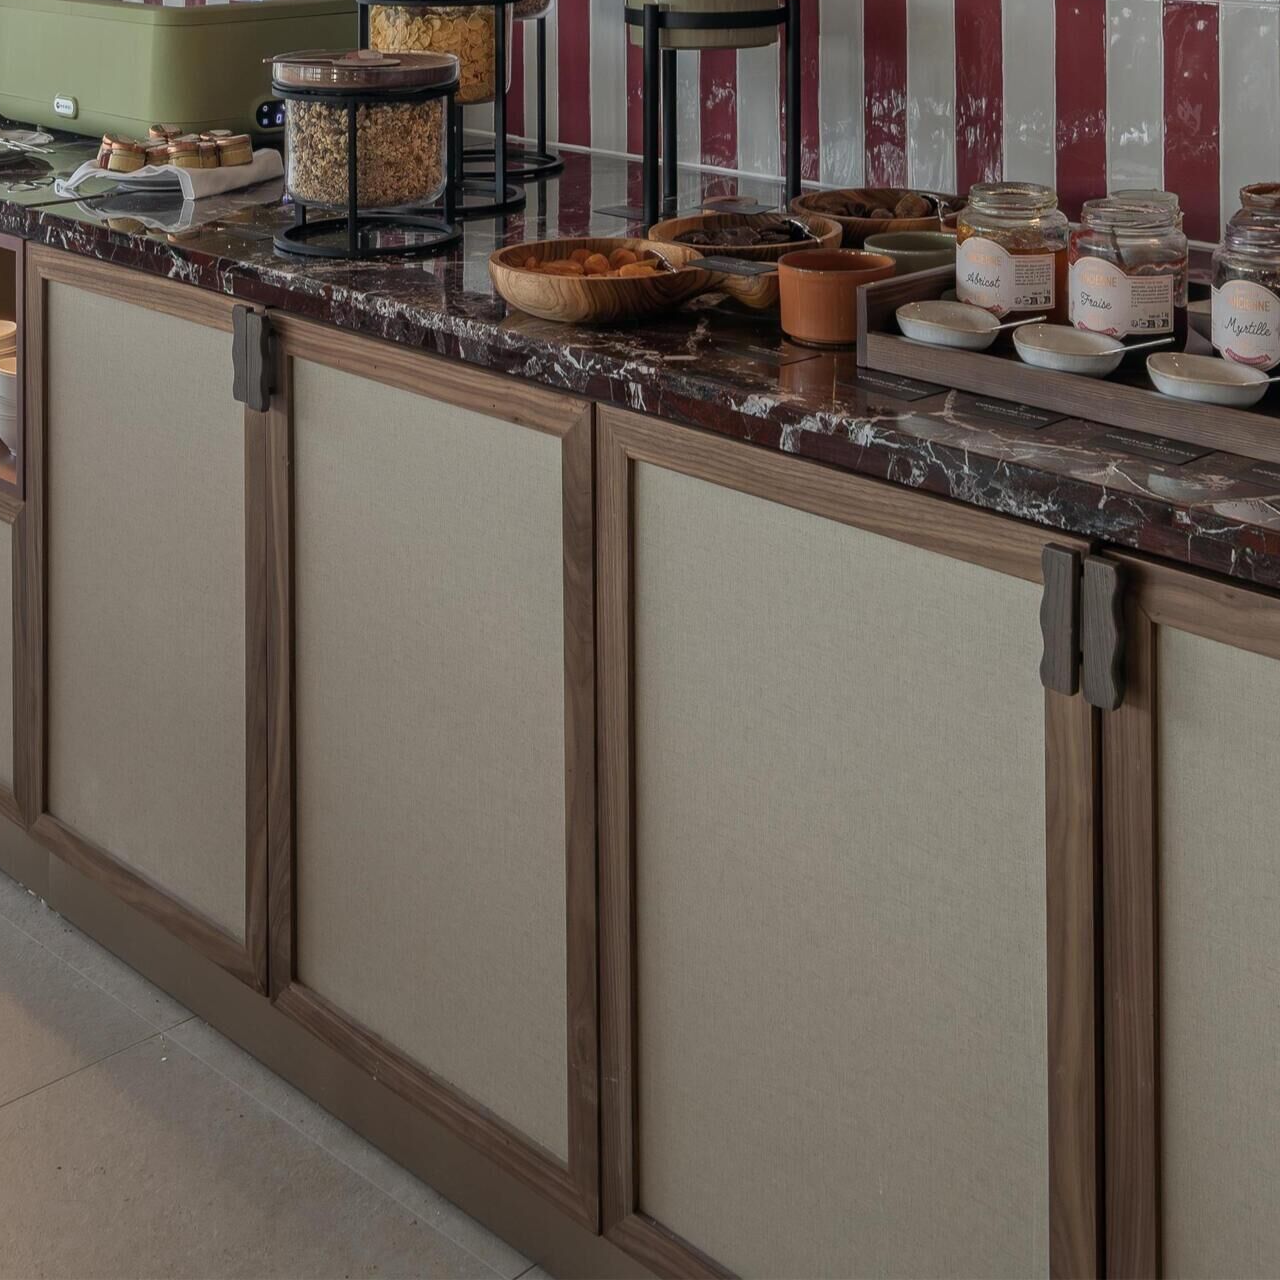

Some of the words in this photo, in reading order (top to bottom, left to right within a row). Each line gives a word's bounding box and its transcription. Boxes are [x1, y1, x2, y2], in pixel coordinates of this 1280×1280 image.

[966, 271, 1001, 289] Abricot
[1080, 291, 1113, 311] Fraise
[1224, 316, 1272, 337] Myrtille
